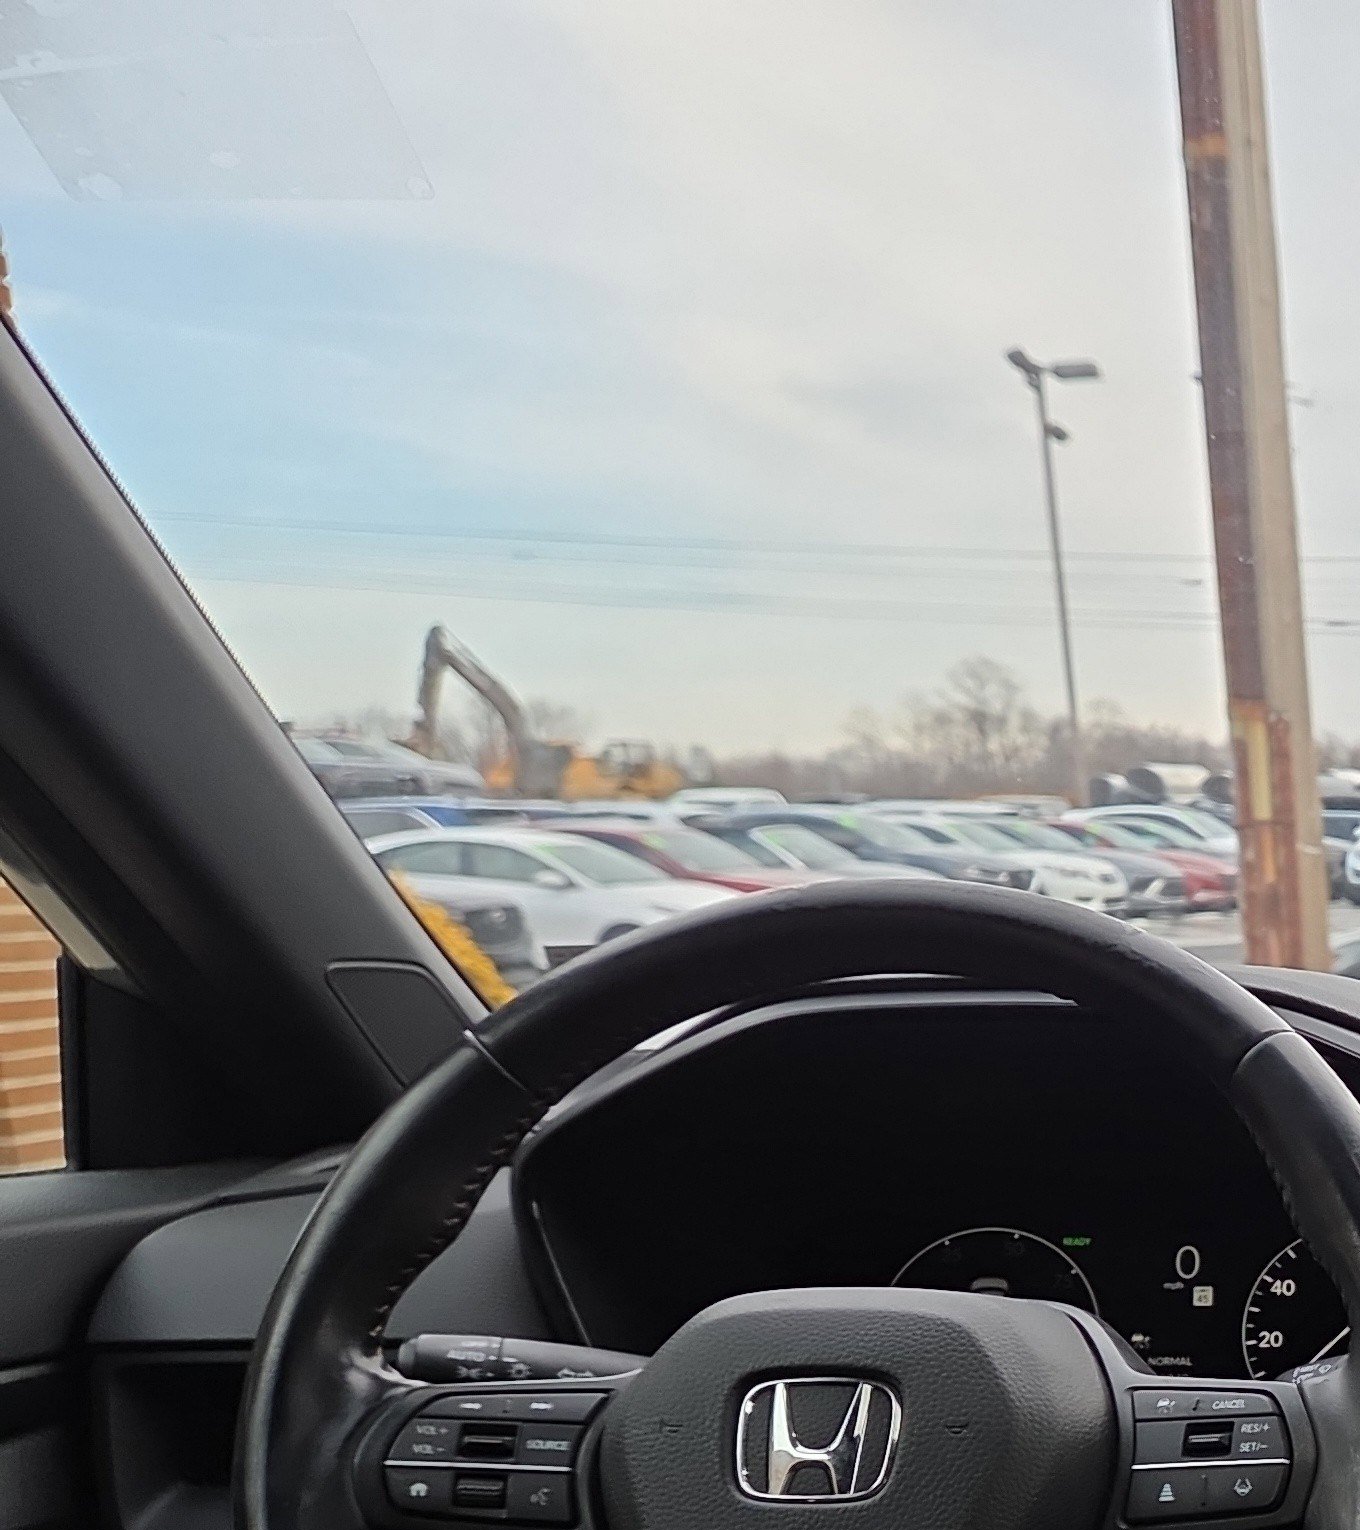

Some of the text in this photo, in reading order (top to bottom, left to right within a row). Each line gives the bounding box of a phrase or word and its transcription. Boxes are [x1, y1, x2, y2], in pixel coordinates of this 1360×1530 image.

[1175, 1244, 1201, 1280] 0
[1269, 1278, 1297, 1297] 40
[1258, 1330, 1284, 1349] 20
[1147, 1356, 1193, 1367] NORMAL
[1211, 1399, 1246, 1410] CANCEL
[525, 1439, 572, 1451] SOURCE
